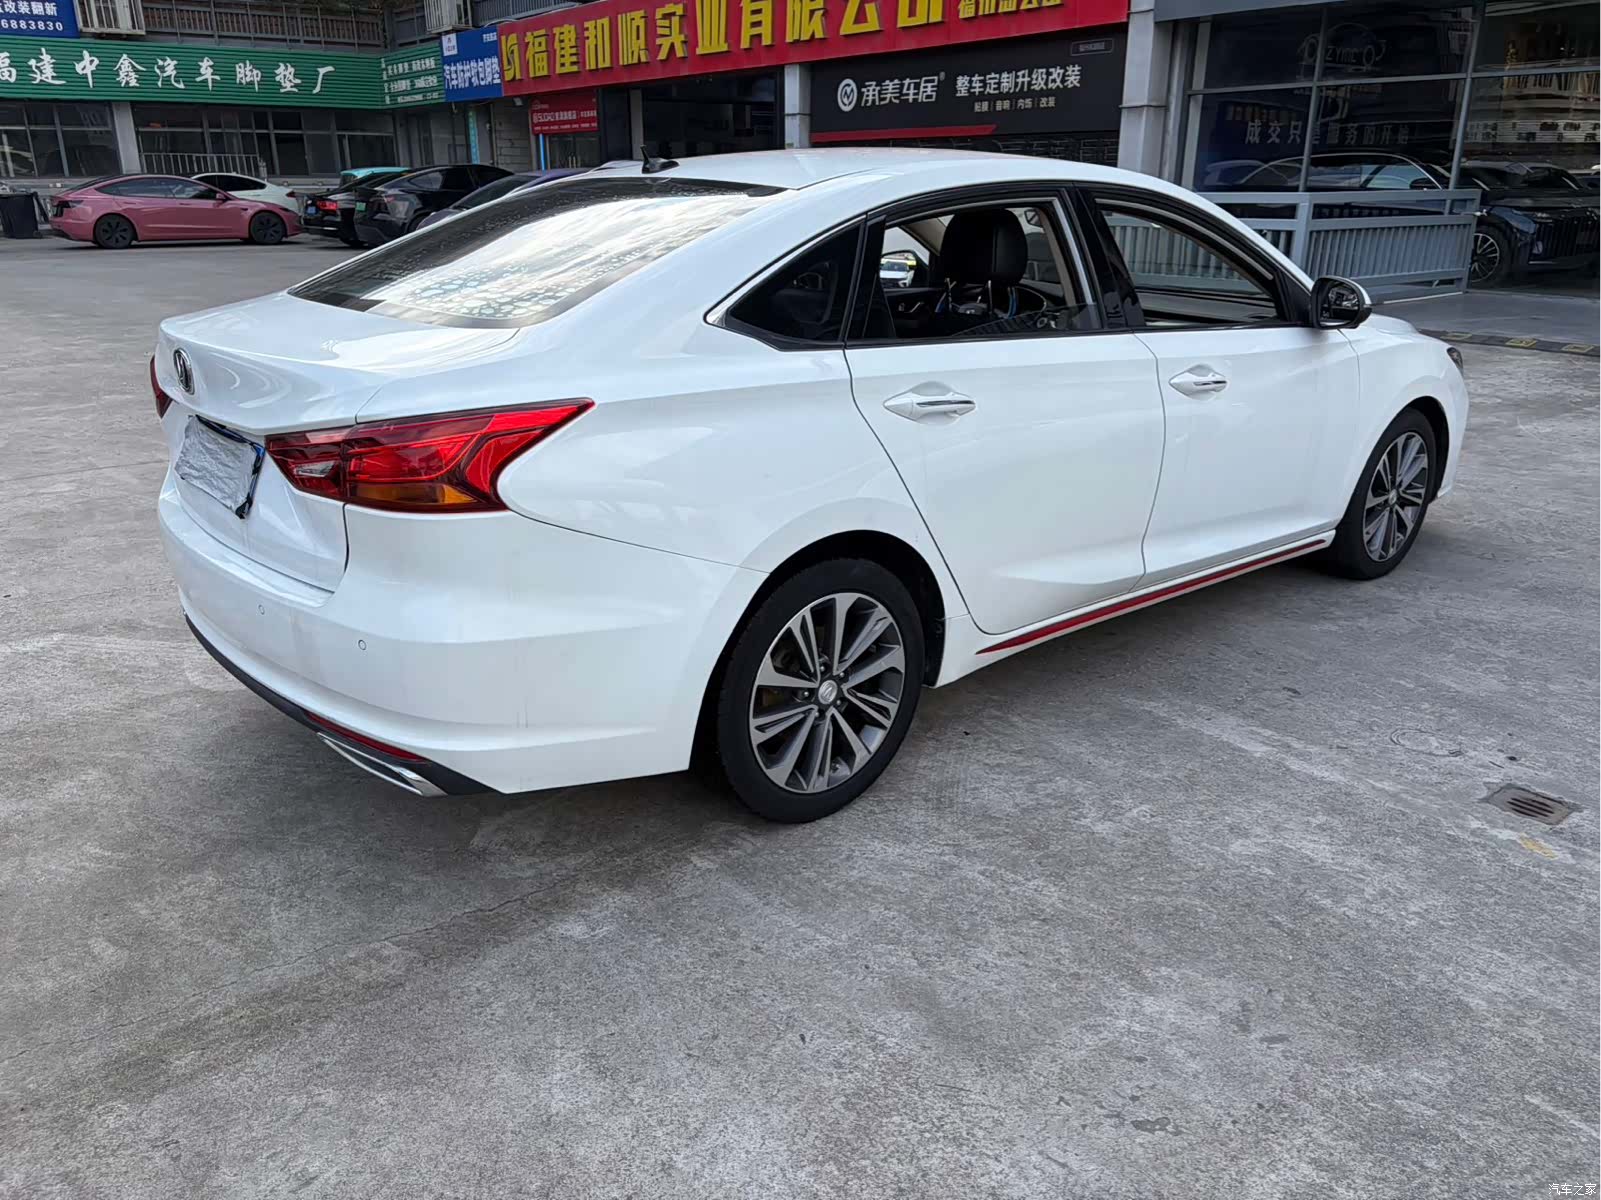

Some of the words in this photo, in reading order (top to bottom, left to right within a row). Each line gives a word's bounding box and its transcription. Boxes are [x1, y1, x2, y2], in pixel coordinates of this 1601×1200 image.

[861, 76, 938, 107] 承美车居
[955, 64, 1082, 97] 整车定制升级改装
